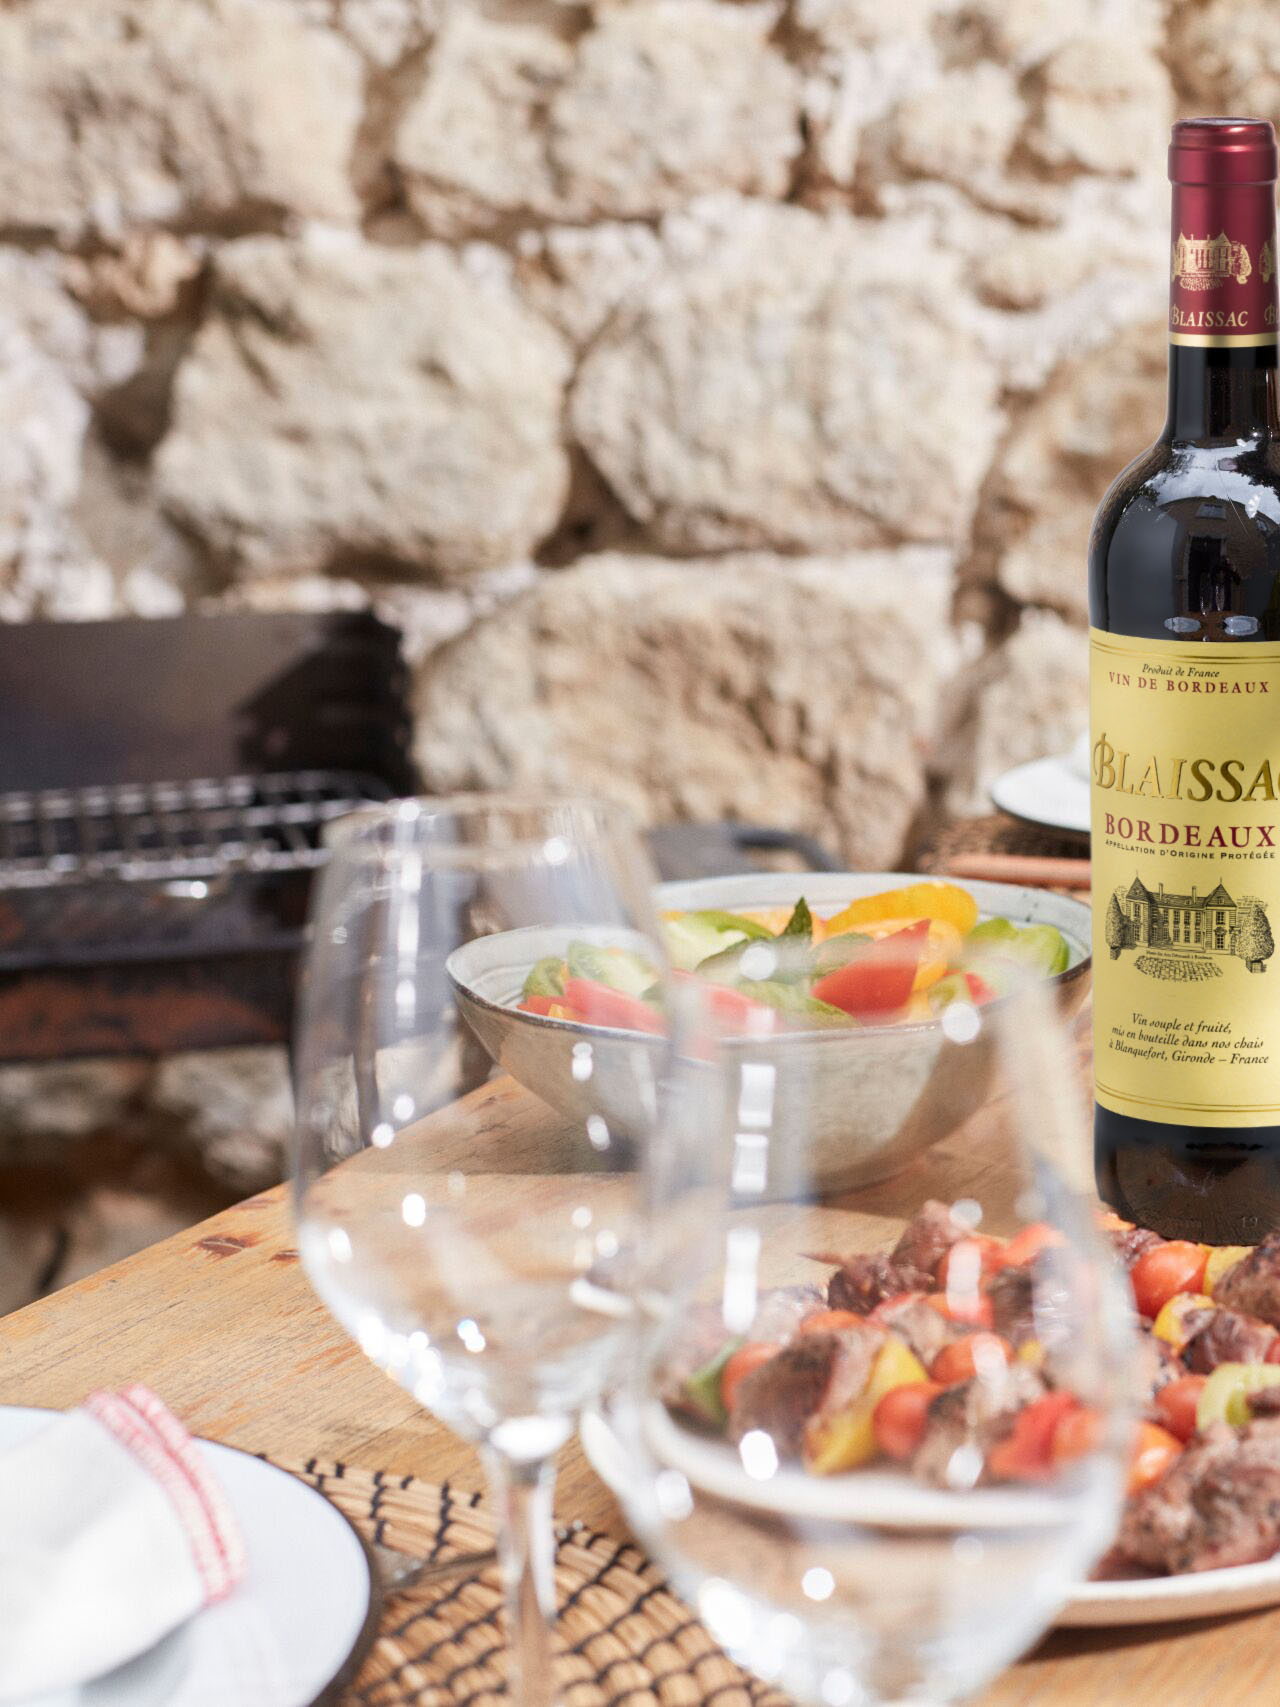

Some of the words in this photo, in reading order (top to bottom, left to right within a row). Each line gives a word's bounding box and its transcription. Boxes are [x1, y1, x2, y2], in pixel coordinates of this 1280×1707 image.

[1170, 303, 1248, 327] BLAISSAC
[1142, 663, 1173, 676] Produit
[1175, 666, 1185, 677] de
[1187, 667, 1220, 678] France
[1108, 671, 1130, 686] VIN
[1138, 676, 1157, 690] DE
[1166, 680, 1270, 694] BORDEAUX
[1104, 812, 1276, 848] BORDEAUX
[1220, 850, 1275, 860] PROTÉGÉE
[1131, 1012, 1147, 1026] Vin
[1149, 1018, 1182, 1032] souple
[1184, 1022, 1194, 1032] et
[1195, 1020, 1232, 1035] fruité,
[1111, 1025, 1125, 1036] mis
[1126, 1030, 1136, 1040] en
[1138, 1029, 1179, 1046] bouteille
[1182, 1035, 1208, 1048] dans
[1211, 1040, 1231, 1048] nos
[1233, 1037, 1264, 1049] chais
[1108, 1039, 1114, 1049] à
[1115, 1039, 1168, 1061] Blanquefort,
[1171, 1050, 1216, 1064] Gironde
[1230, 1053, 1270, 1064] France
